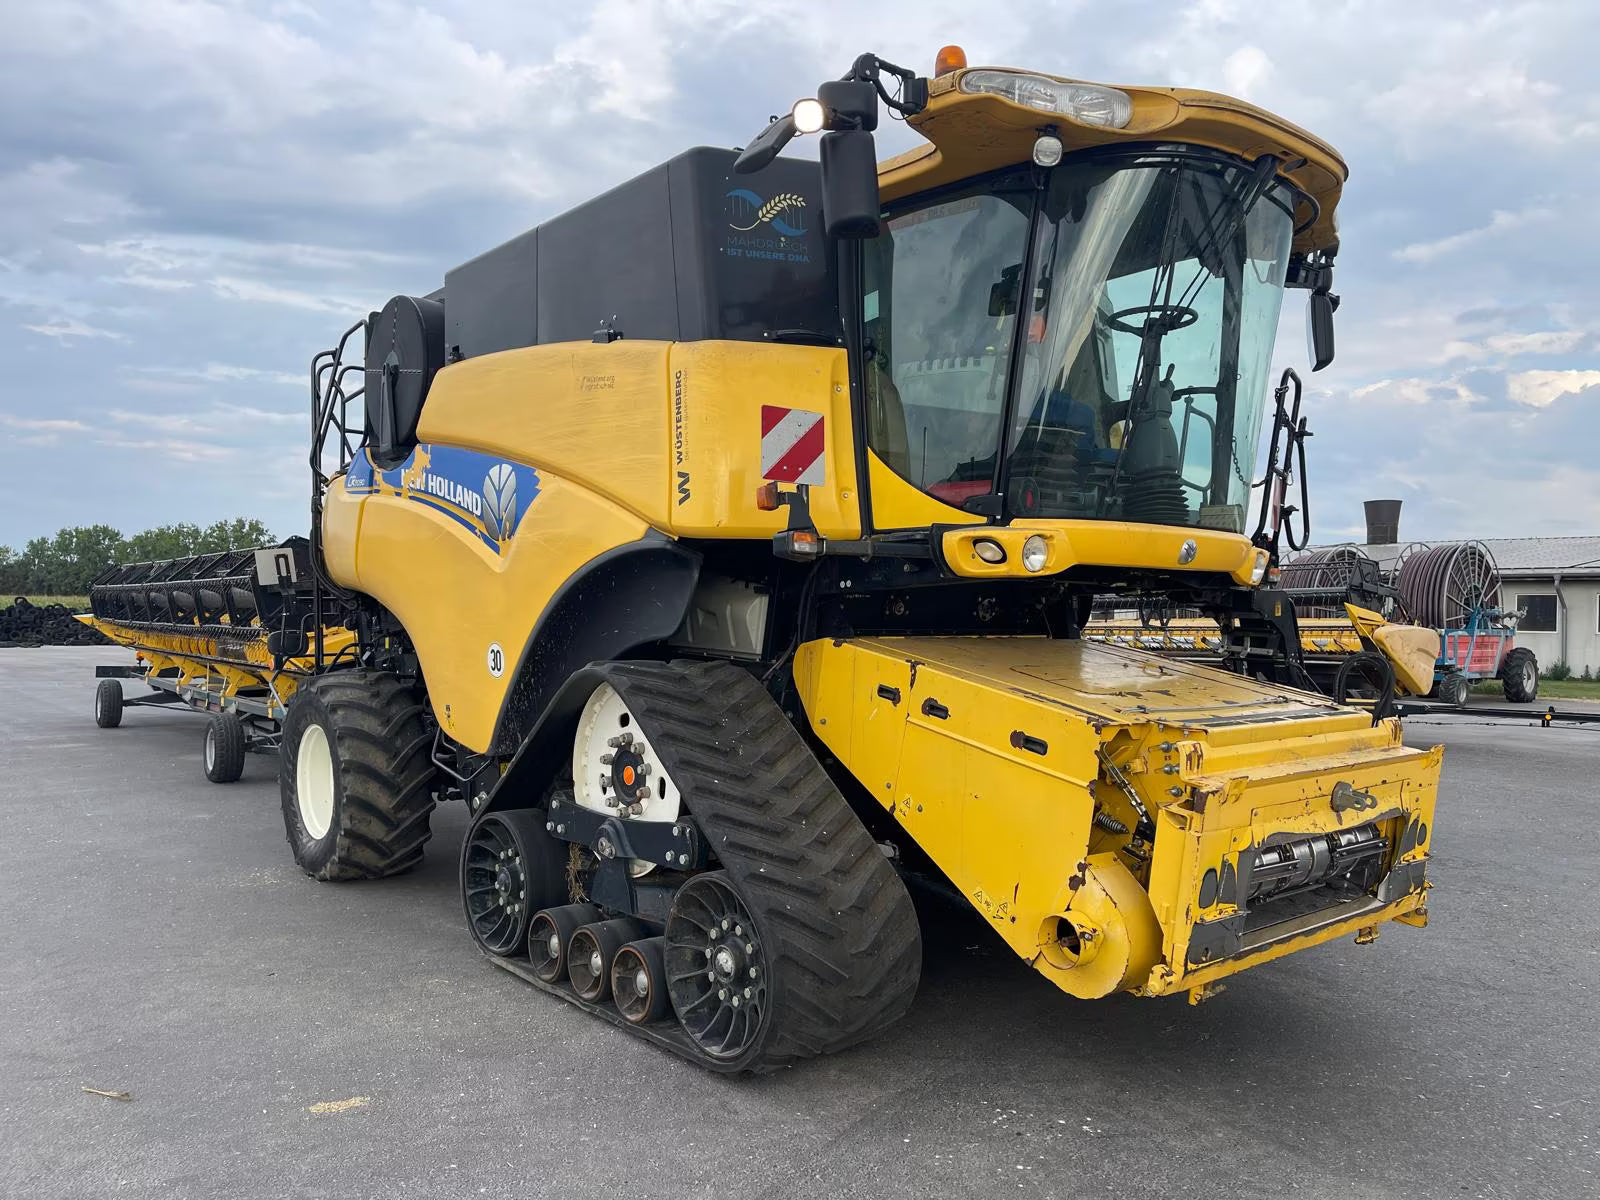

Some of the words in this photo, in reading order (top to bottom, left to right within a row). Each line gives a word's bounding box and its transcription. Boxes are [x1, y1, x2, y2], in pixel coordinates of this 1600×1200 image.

[727, 248, 743, 257] IST
[745, 250, 786, 261] UNSERE
[787, 253, 810, 263] DNA
[674, 370, 683, 465] WÜSTENBERG
[428, 473, 482, 516] HOLLAND
[490, 648, 502, 672] 30
